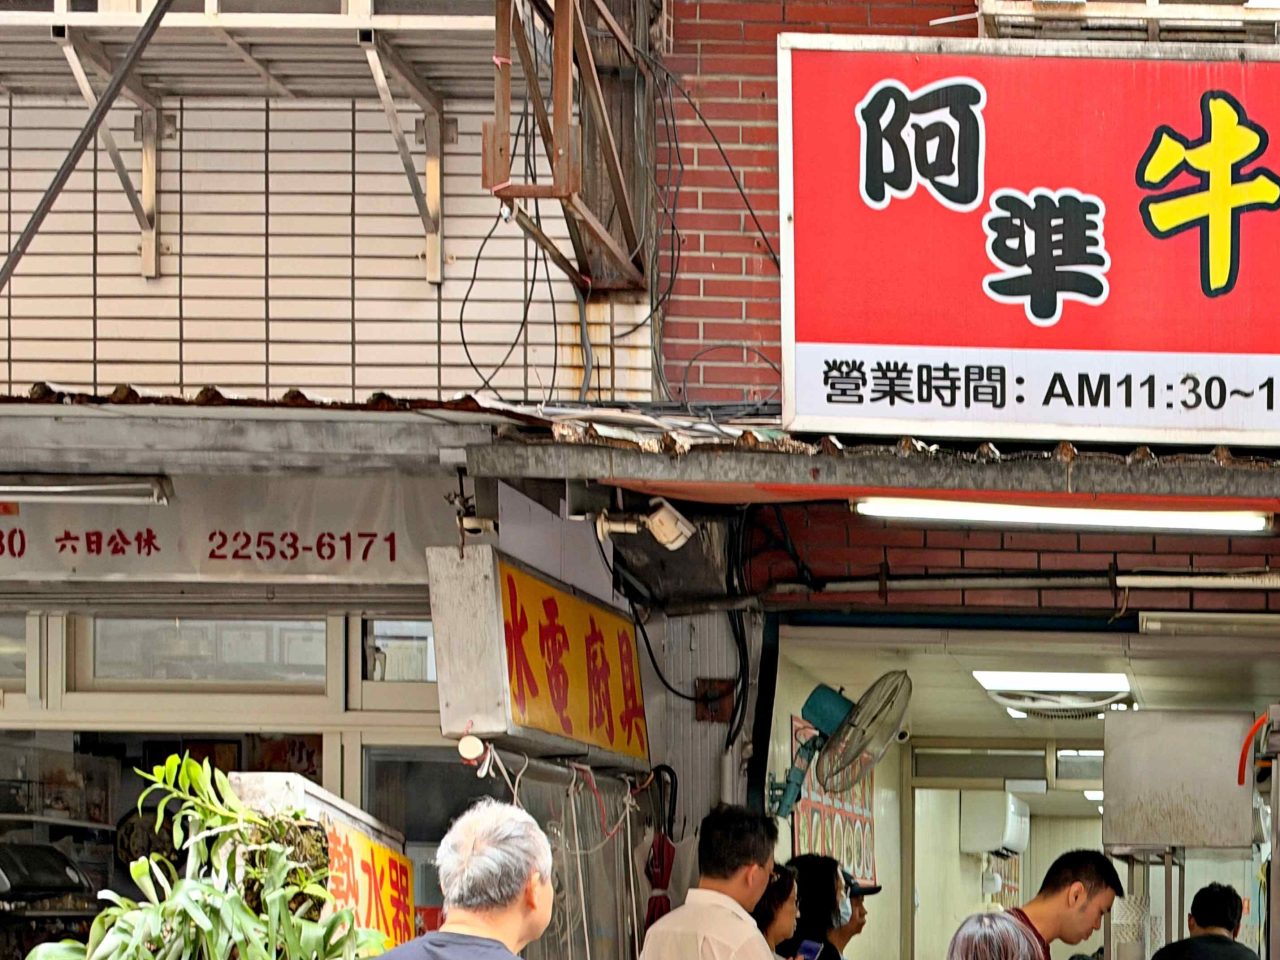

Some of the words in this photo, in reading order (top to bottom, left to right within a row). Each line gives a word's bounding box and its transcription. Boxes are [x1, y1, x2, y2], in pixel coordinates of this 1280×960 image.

[55, 528, 161, 556] 六日公休
[208, 530, 397, 561] 2253-6171
[504, 573, 646, 753] 水電廚具
